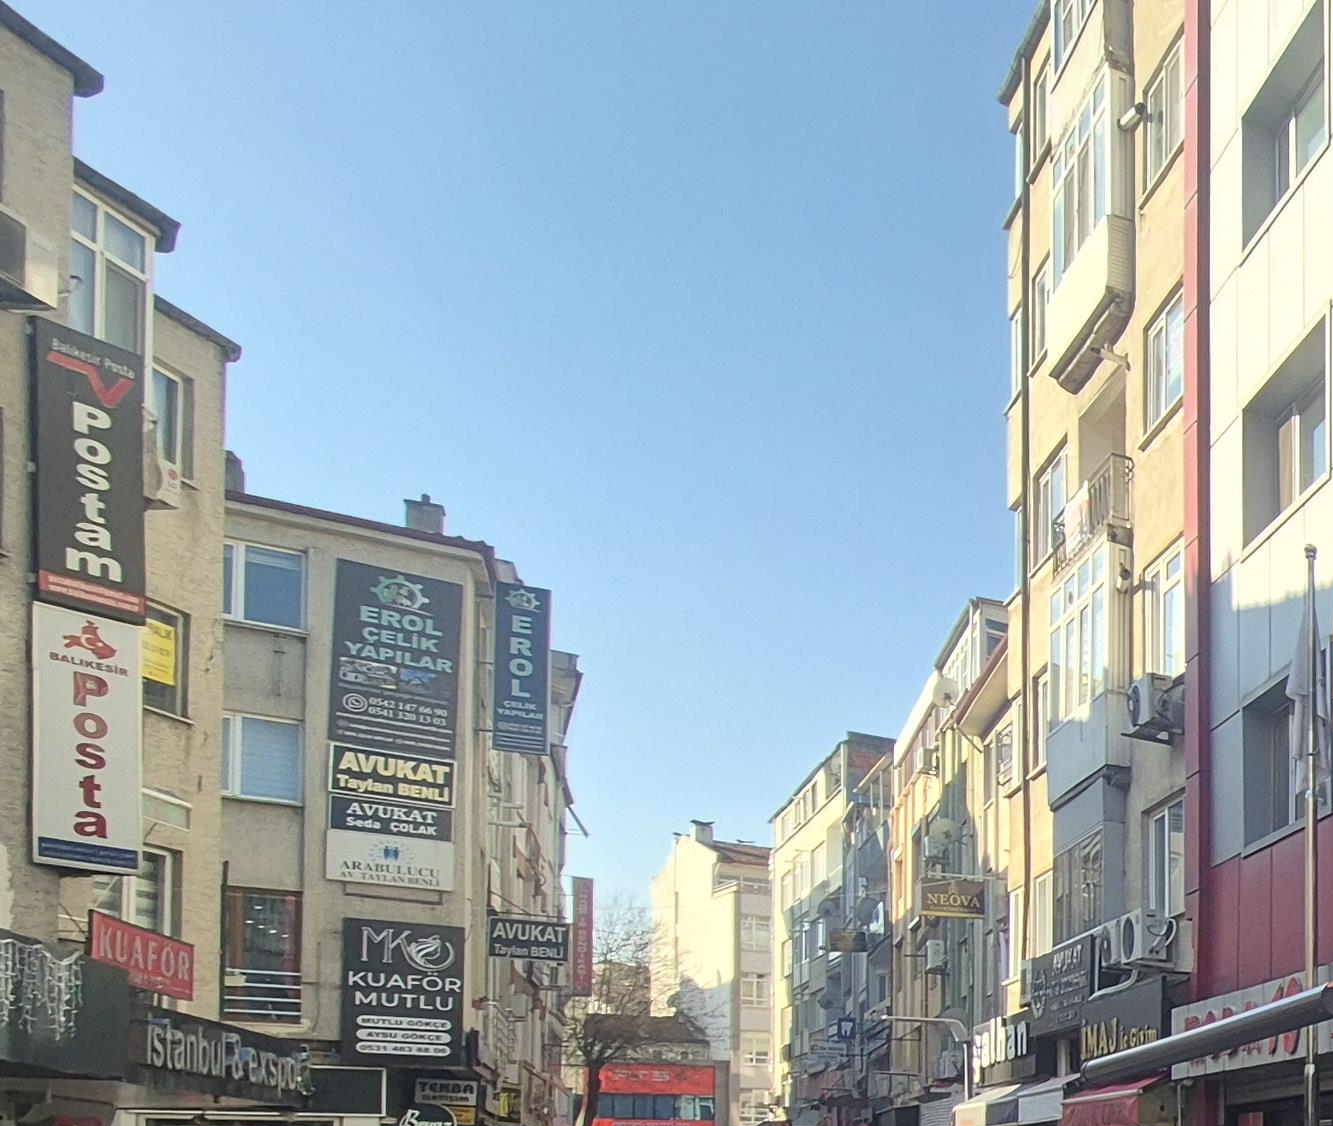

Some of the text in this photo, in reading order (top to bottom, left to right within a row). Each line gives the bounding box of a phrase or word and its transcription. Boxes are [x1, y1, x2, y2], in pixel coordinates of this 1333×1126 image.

[359, 605, 443, 636] EROL
[362, 626, 439, 653] ÇELİK
[49, 651, 129, 677] BALIKESİR
[344, 640, 453, 673] YAPILAR
[509, 614, 533, 698] EROL
[338, 751, 450, 784] AVUKAT
[336, 774, 449, 802] Taylan BENLİ
[346, 802, 437, 824] AVUKAT
[346, 816, 437, 836] Seda ÇOLAK
[340, 860, 440, 879] ARABULUCU
[362, 872, 405, 883] TAYLAN
[927, 892, 981, 908] NEOVA
[492, 922, 567, 944] AVUKAT
[100, 926, 190, 982] KUAFÖR
[494, 943, 528, 958] Taylan
[348, 971, 461, 992] KUAFÖR
[355, 990, 453, 1011] MUTLU
